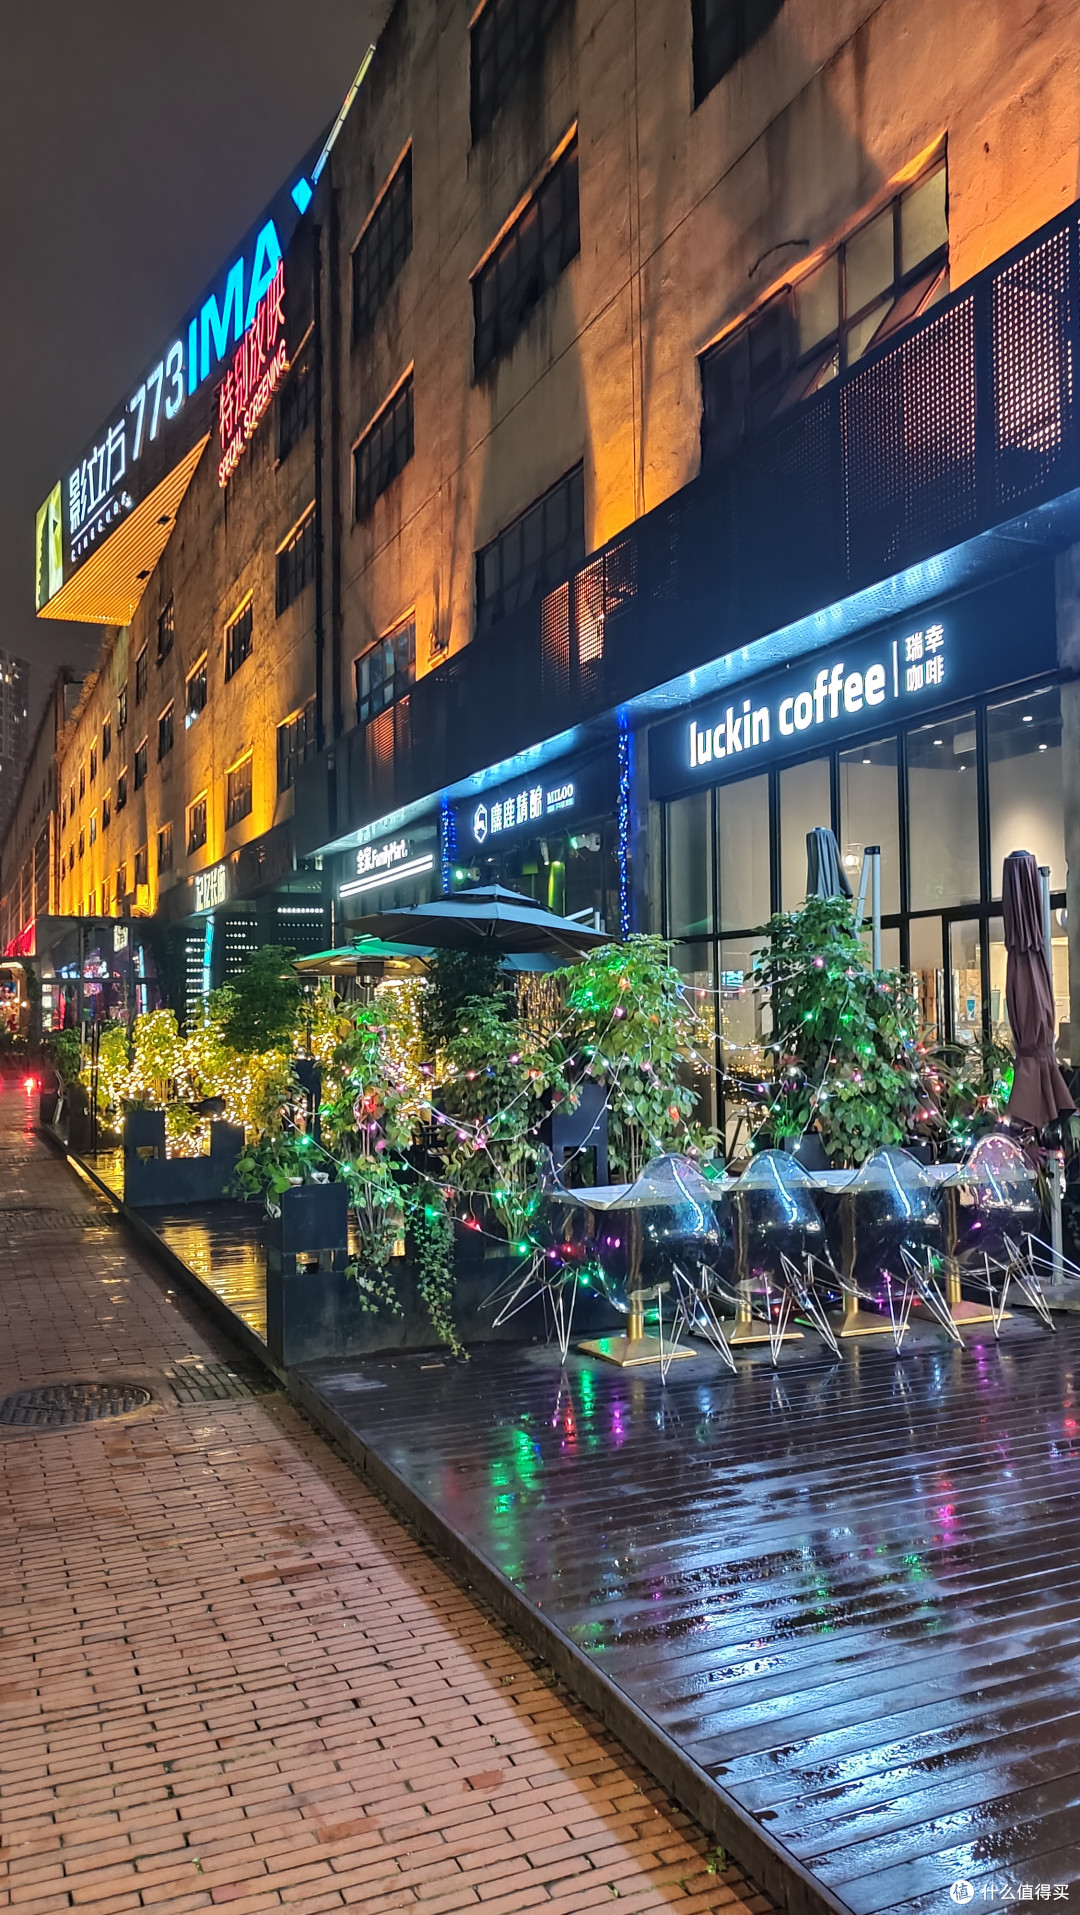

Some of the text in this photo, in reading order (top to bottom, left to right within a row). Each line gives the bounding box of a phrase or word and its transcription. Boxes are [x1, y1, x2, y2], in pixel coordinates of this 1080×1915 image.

[219, 256, 285, 449] 特别放映
[244, 339, 287, 439] SCREENING
[70, 418, 125, 534] 影立方
[130, 339, 185, 462] 773
[904, 623, 945, 663] 瑞幸
[905, 655, 945, 693] 咖啡
[689, 662, 886, 768] luckin coffee
